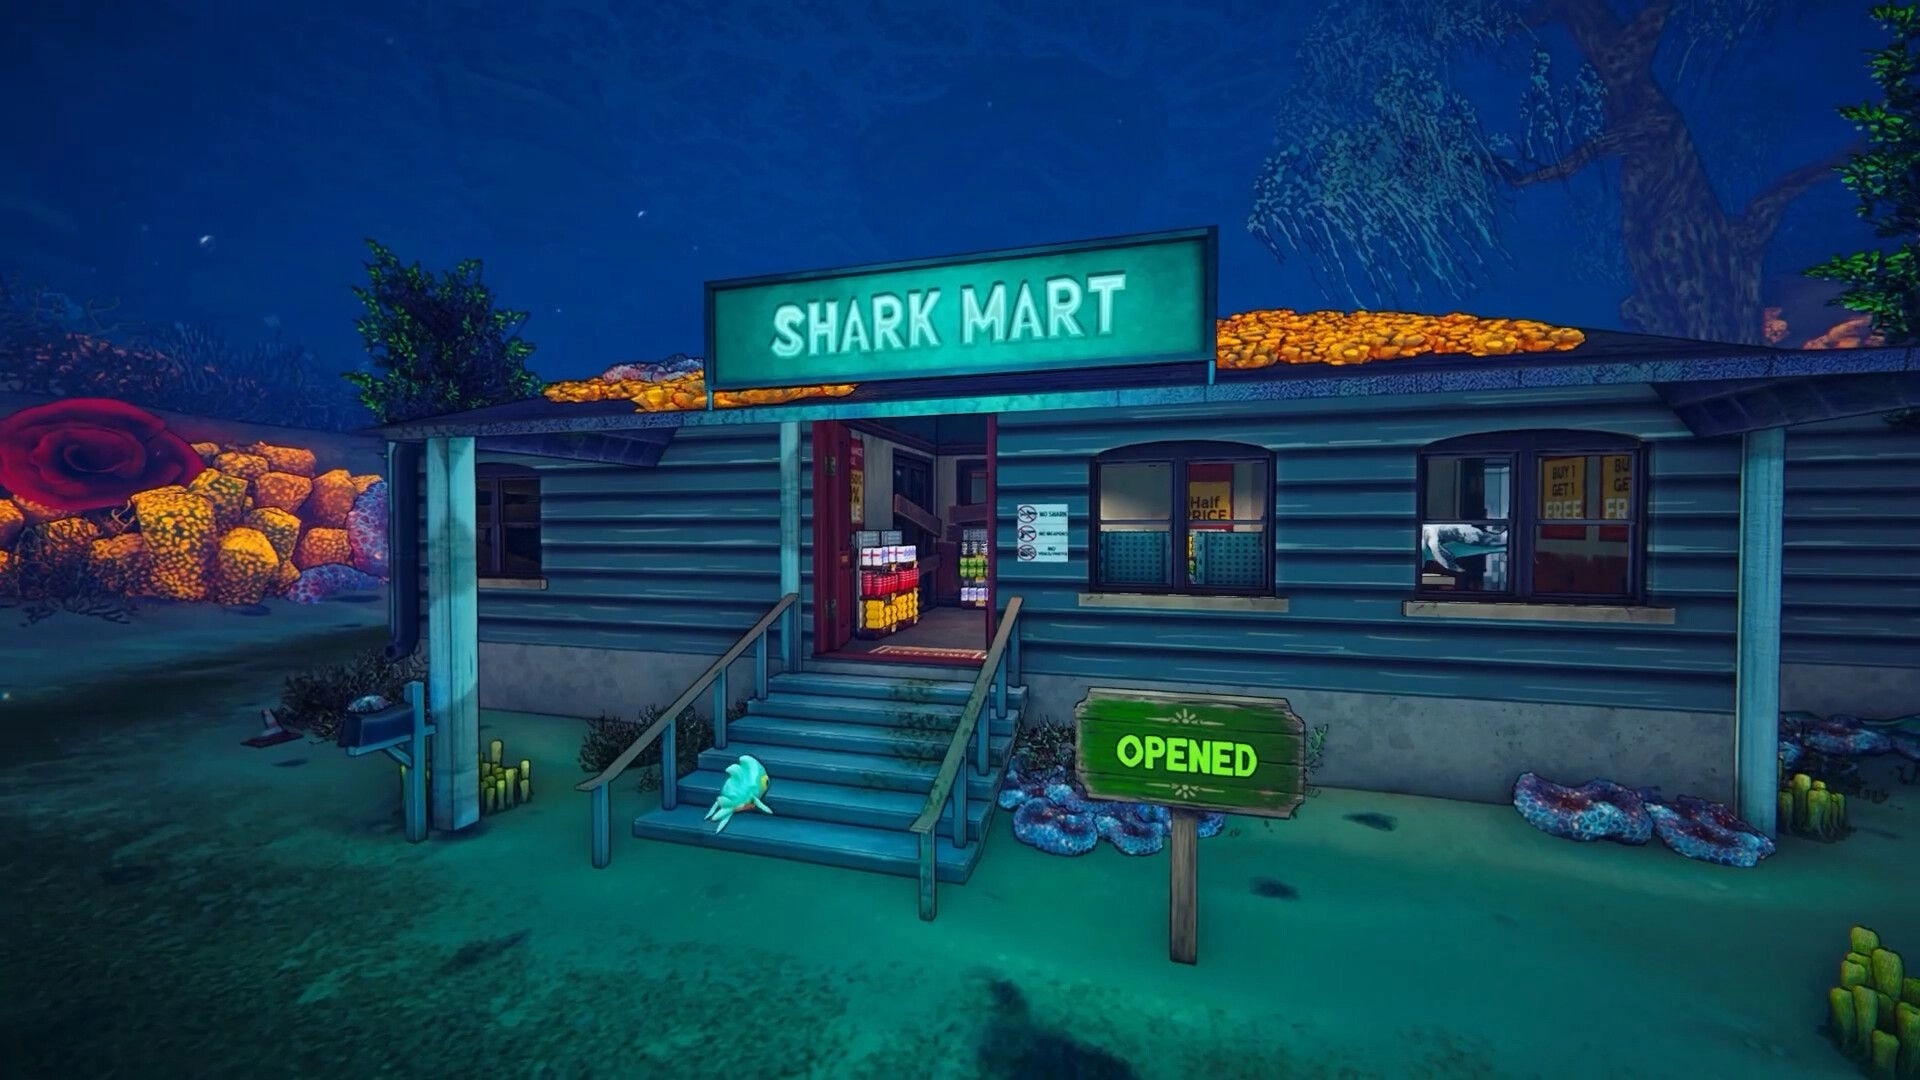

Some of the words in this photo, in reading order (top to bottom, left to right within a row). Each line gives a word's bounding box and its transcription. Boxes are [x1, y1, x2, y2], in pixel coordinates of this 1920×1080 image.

[771, 288, 942, 358] SHARK
[960, 273, 1127, 345] MART
[1552, 465, 1569, 480] BUY
[1614, 458, 1631, 472] BU
[1552, 482, 1569, 497] GET
[1614, 477, 1631, 492] GE
[1190, 495, 1221, 509] Half
[1545, 500, 1585, 519] FREE
[1603, 498, 1629, 519] FR
[1188, 509, 1227, 520] RICE
[1116, 734, 1258, 777] OPENED
